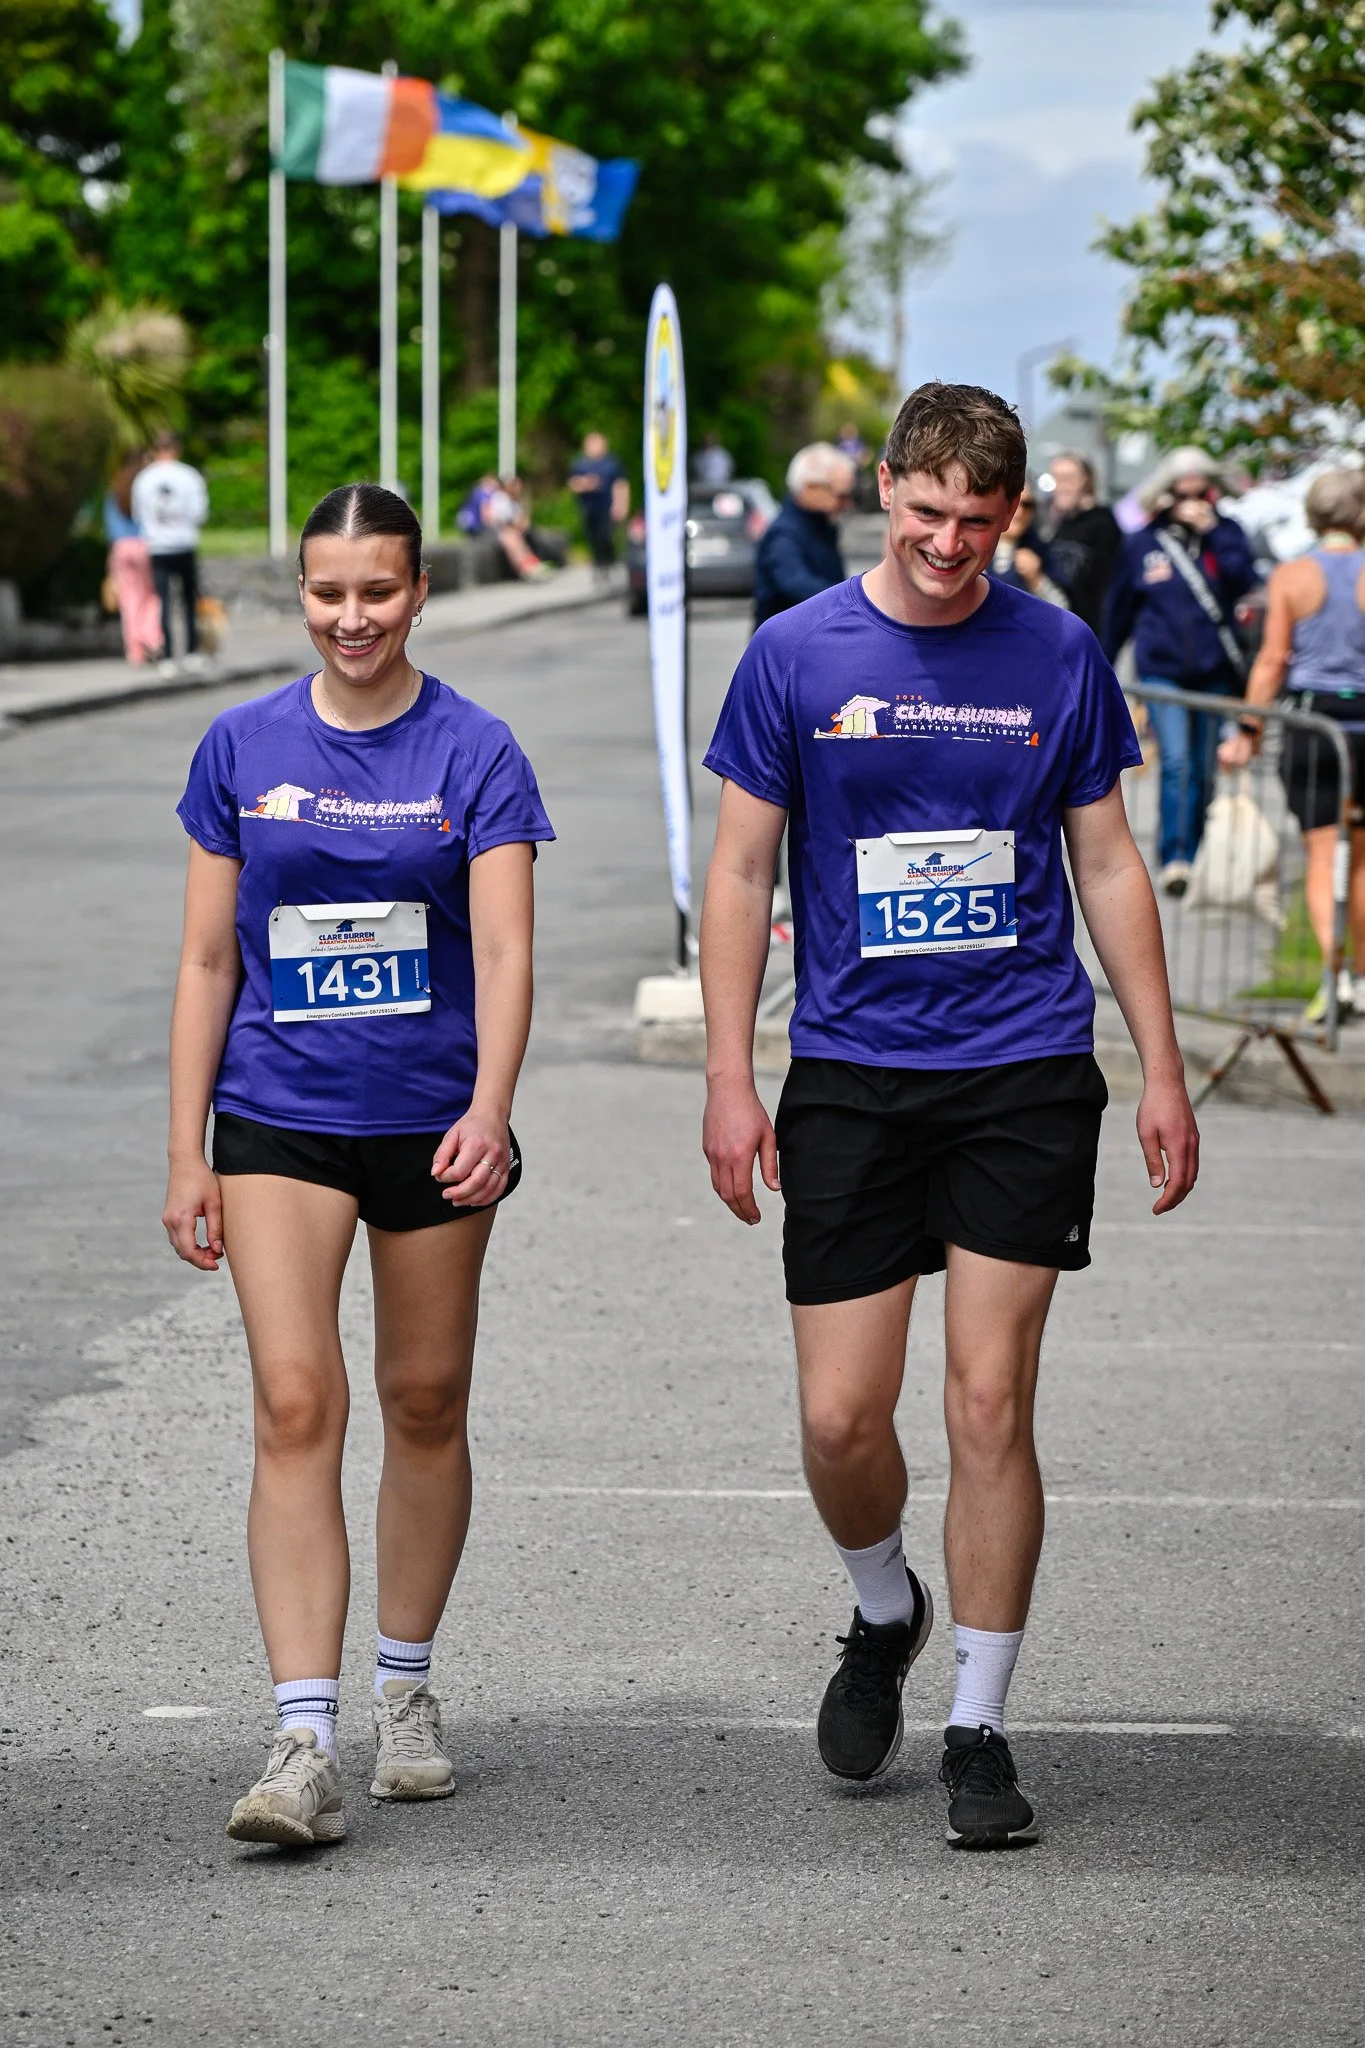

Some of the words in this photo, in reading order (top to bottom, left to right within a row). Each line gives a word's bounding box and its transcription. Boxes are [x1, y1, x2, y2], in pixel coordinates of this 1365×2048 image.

[895, 702, 957, 722] CLARE
[895, 724, 958, 732] MARATHON
[964, 726, 1030, 737] CHALLENGE
[318, 797, 377, 815] CLARE
[315, 814, 375, 826] MARATHON
[381, 816, 443, 825] CHALLENGE
[907, 867, 931, 875] CLARE
[933, 864, 964, 873] BURREN
[875, 889, 997, 939] 1525
[344, 932, 375, 940] BURREN
[297, 955, 401, 1004] 1431
